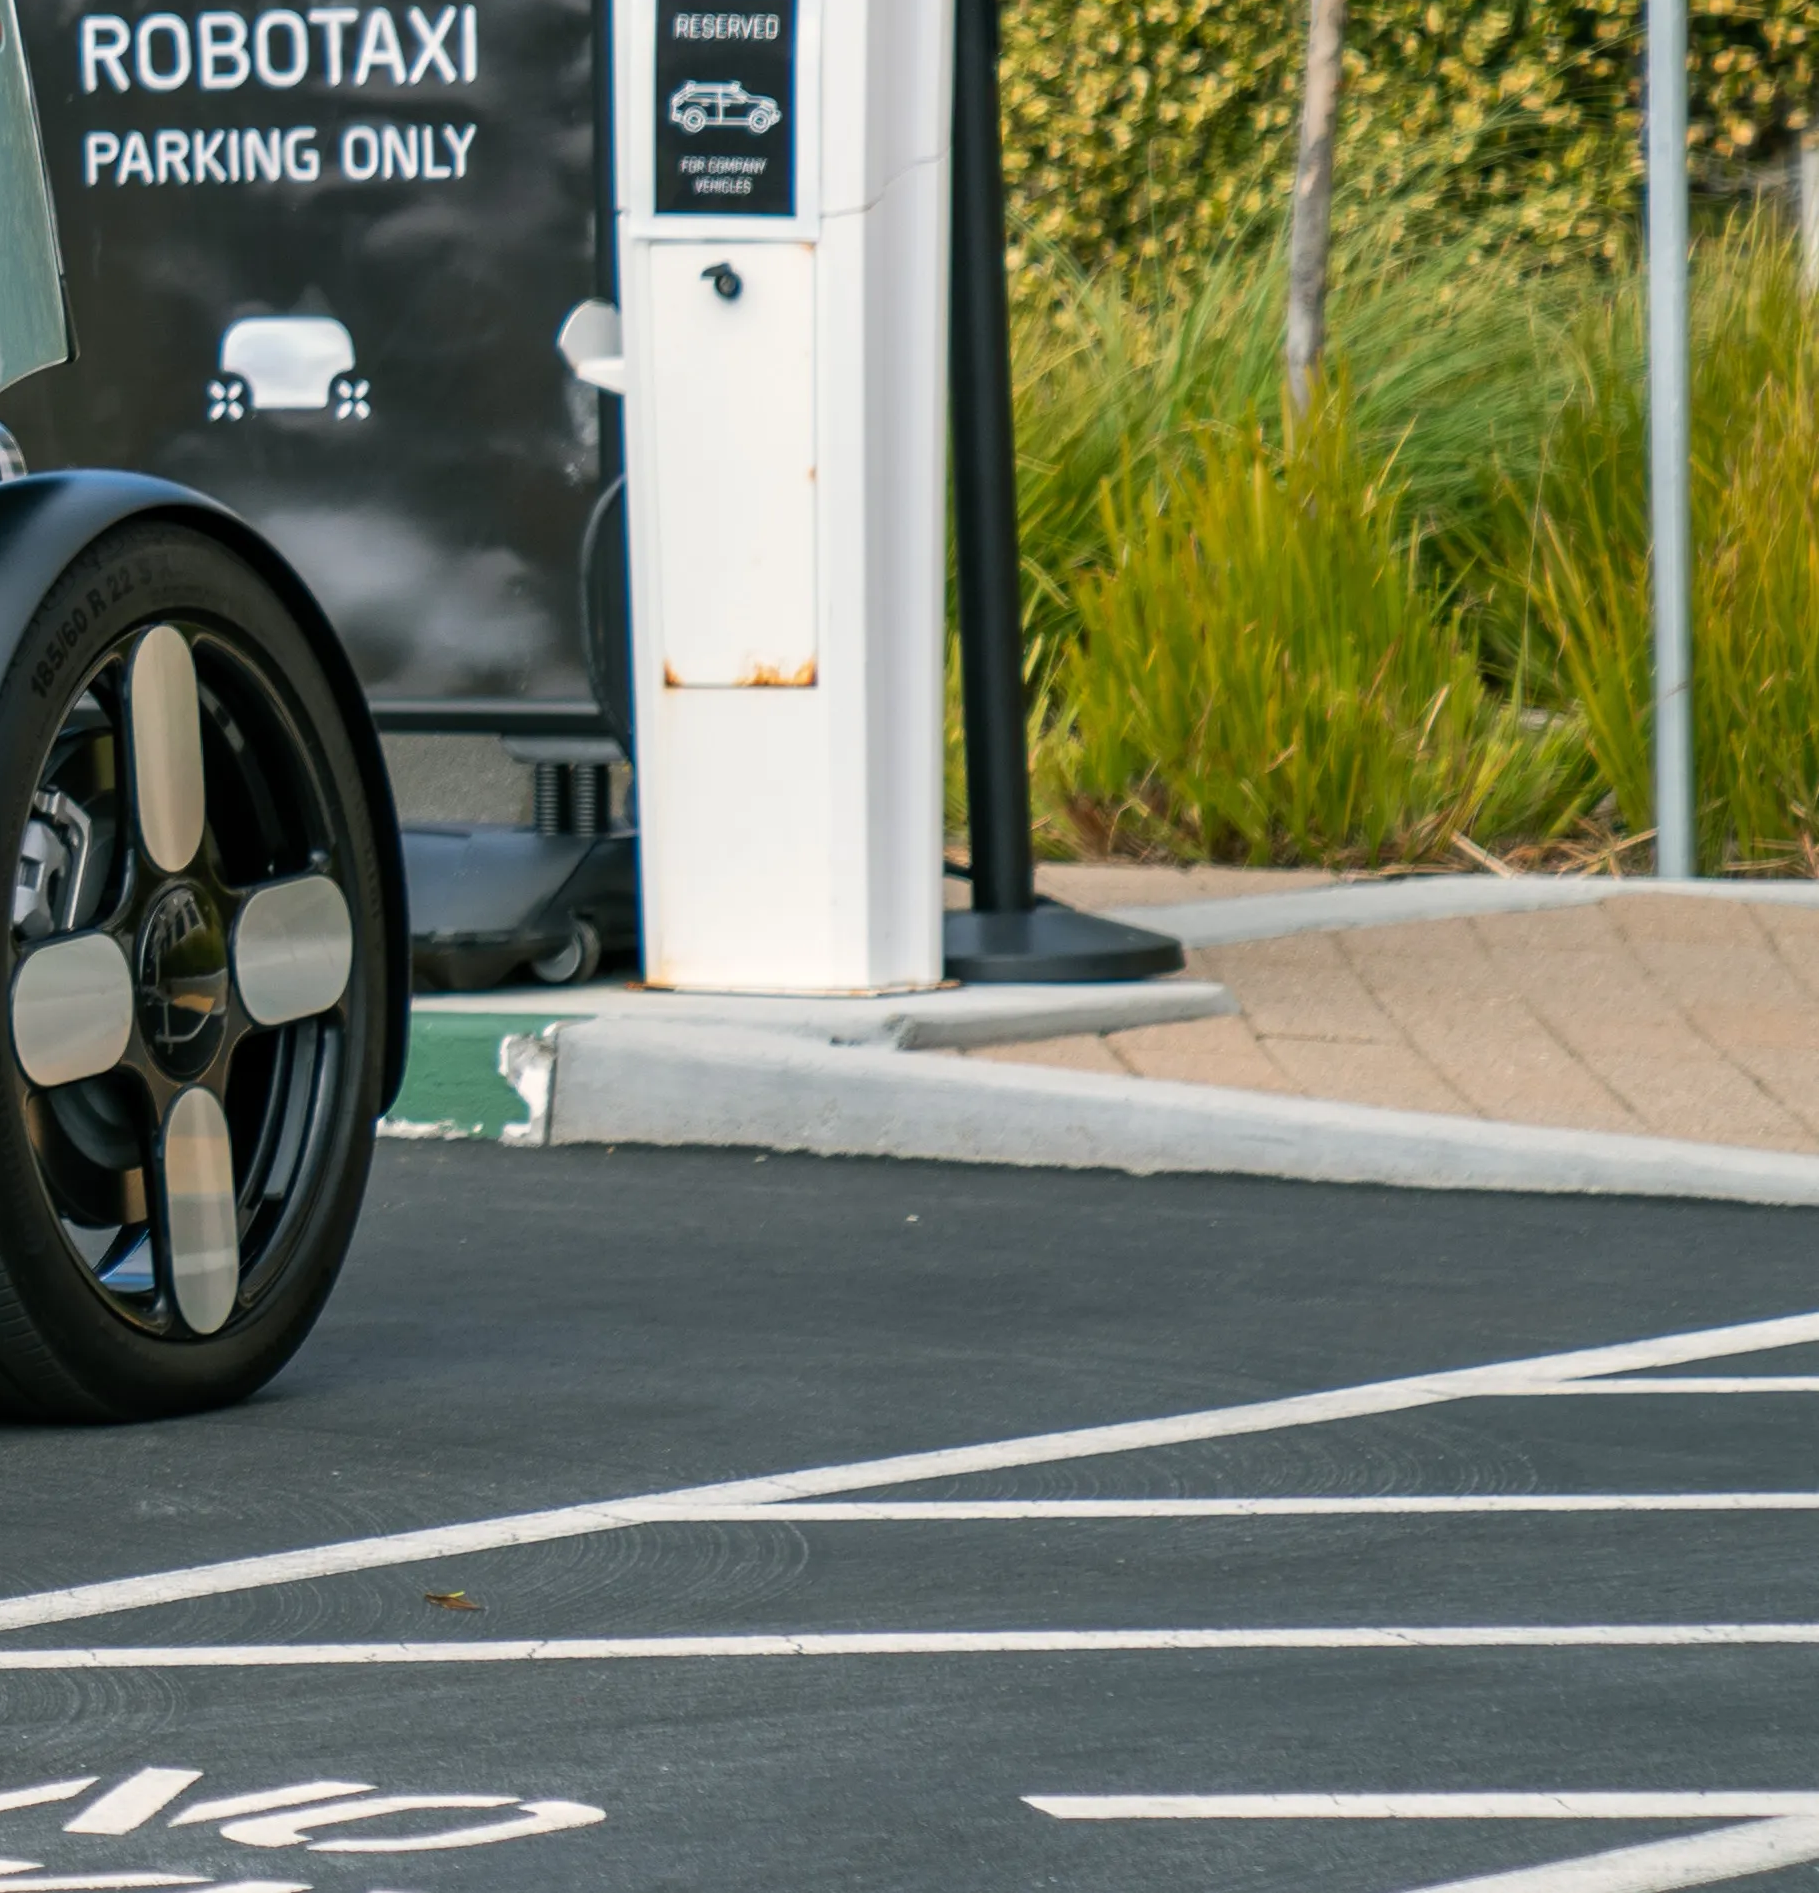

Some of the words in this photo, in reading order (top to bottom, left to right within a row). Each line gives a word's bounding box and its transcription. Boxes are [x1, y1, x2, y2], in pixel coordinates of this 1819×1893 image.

[673, 13, 780, 41] RESERVED
[80, 5, 479, 93] ROBOTAXI
[83, 125, 320, 186] PARKING
[342, 122, 478, 181] ONLY
[679, 156, 706, 175] FOR
[707, 156, 768, 175] COMPANY
[693, 176, 753, 195] VEHICLES
